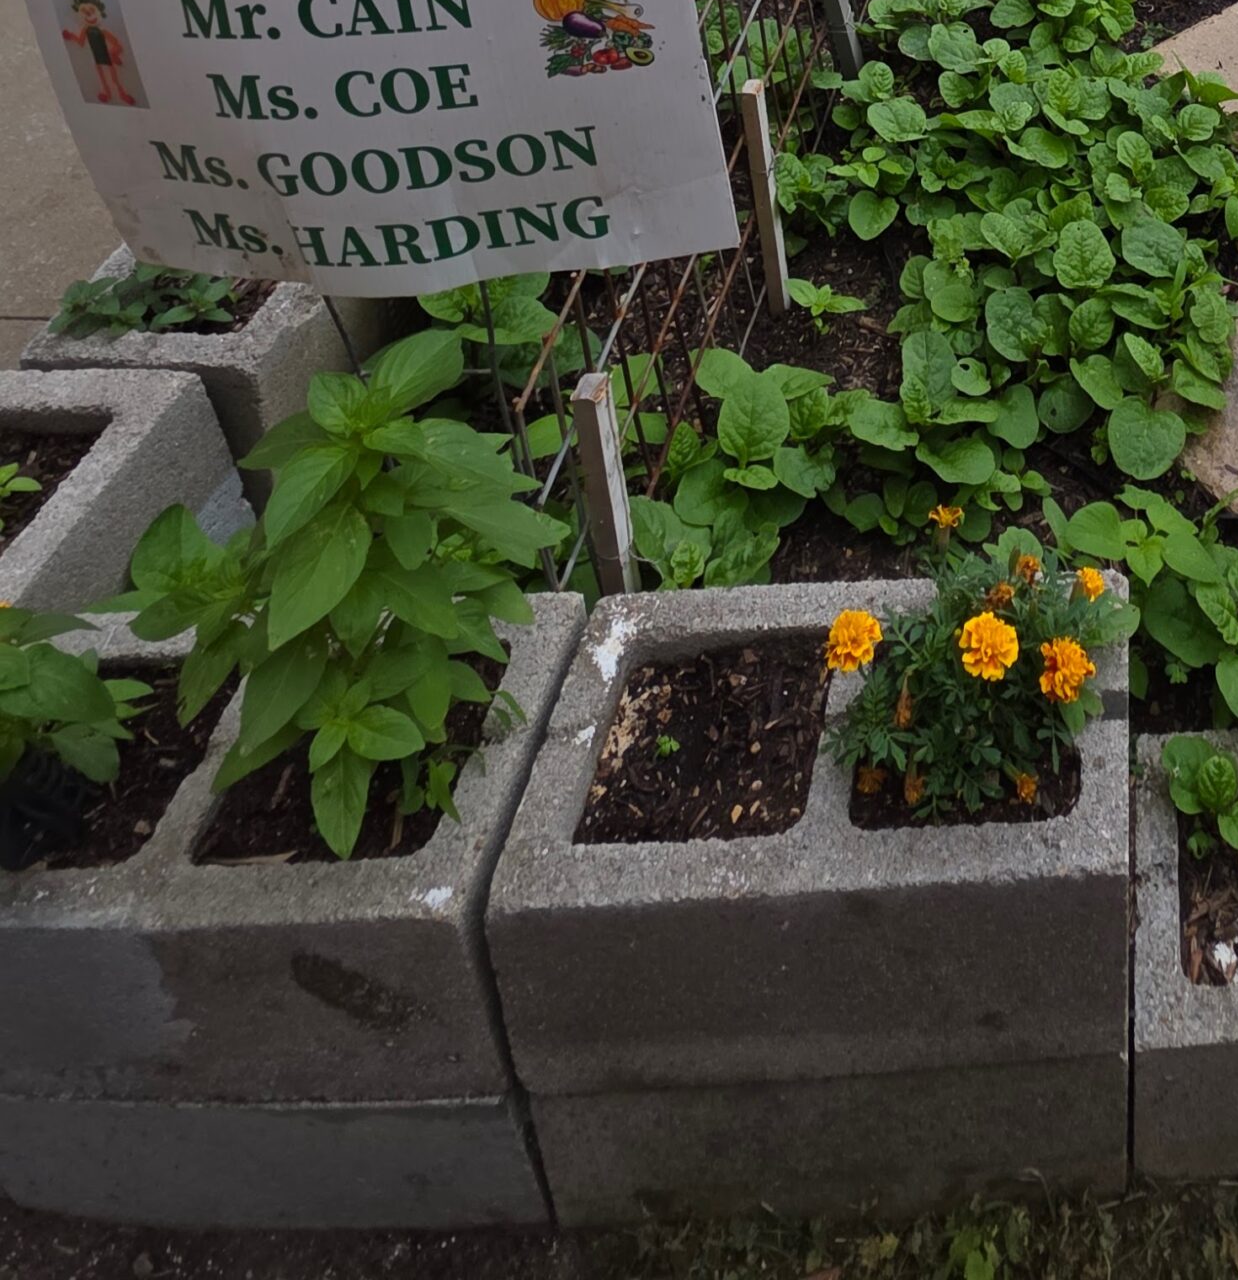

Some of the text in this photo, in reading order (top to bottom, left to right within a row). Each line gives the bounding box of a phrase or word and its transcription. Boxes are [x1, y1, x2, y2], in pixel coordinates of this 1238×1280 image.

[206, 64, 478, 120] Ms. COE
[150, 126, 599, 197] Ms. GOODSON
[183, 196, 611, 267] Ms. HARDING
